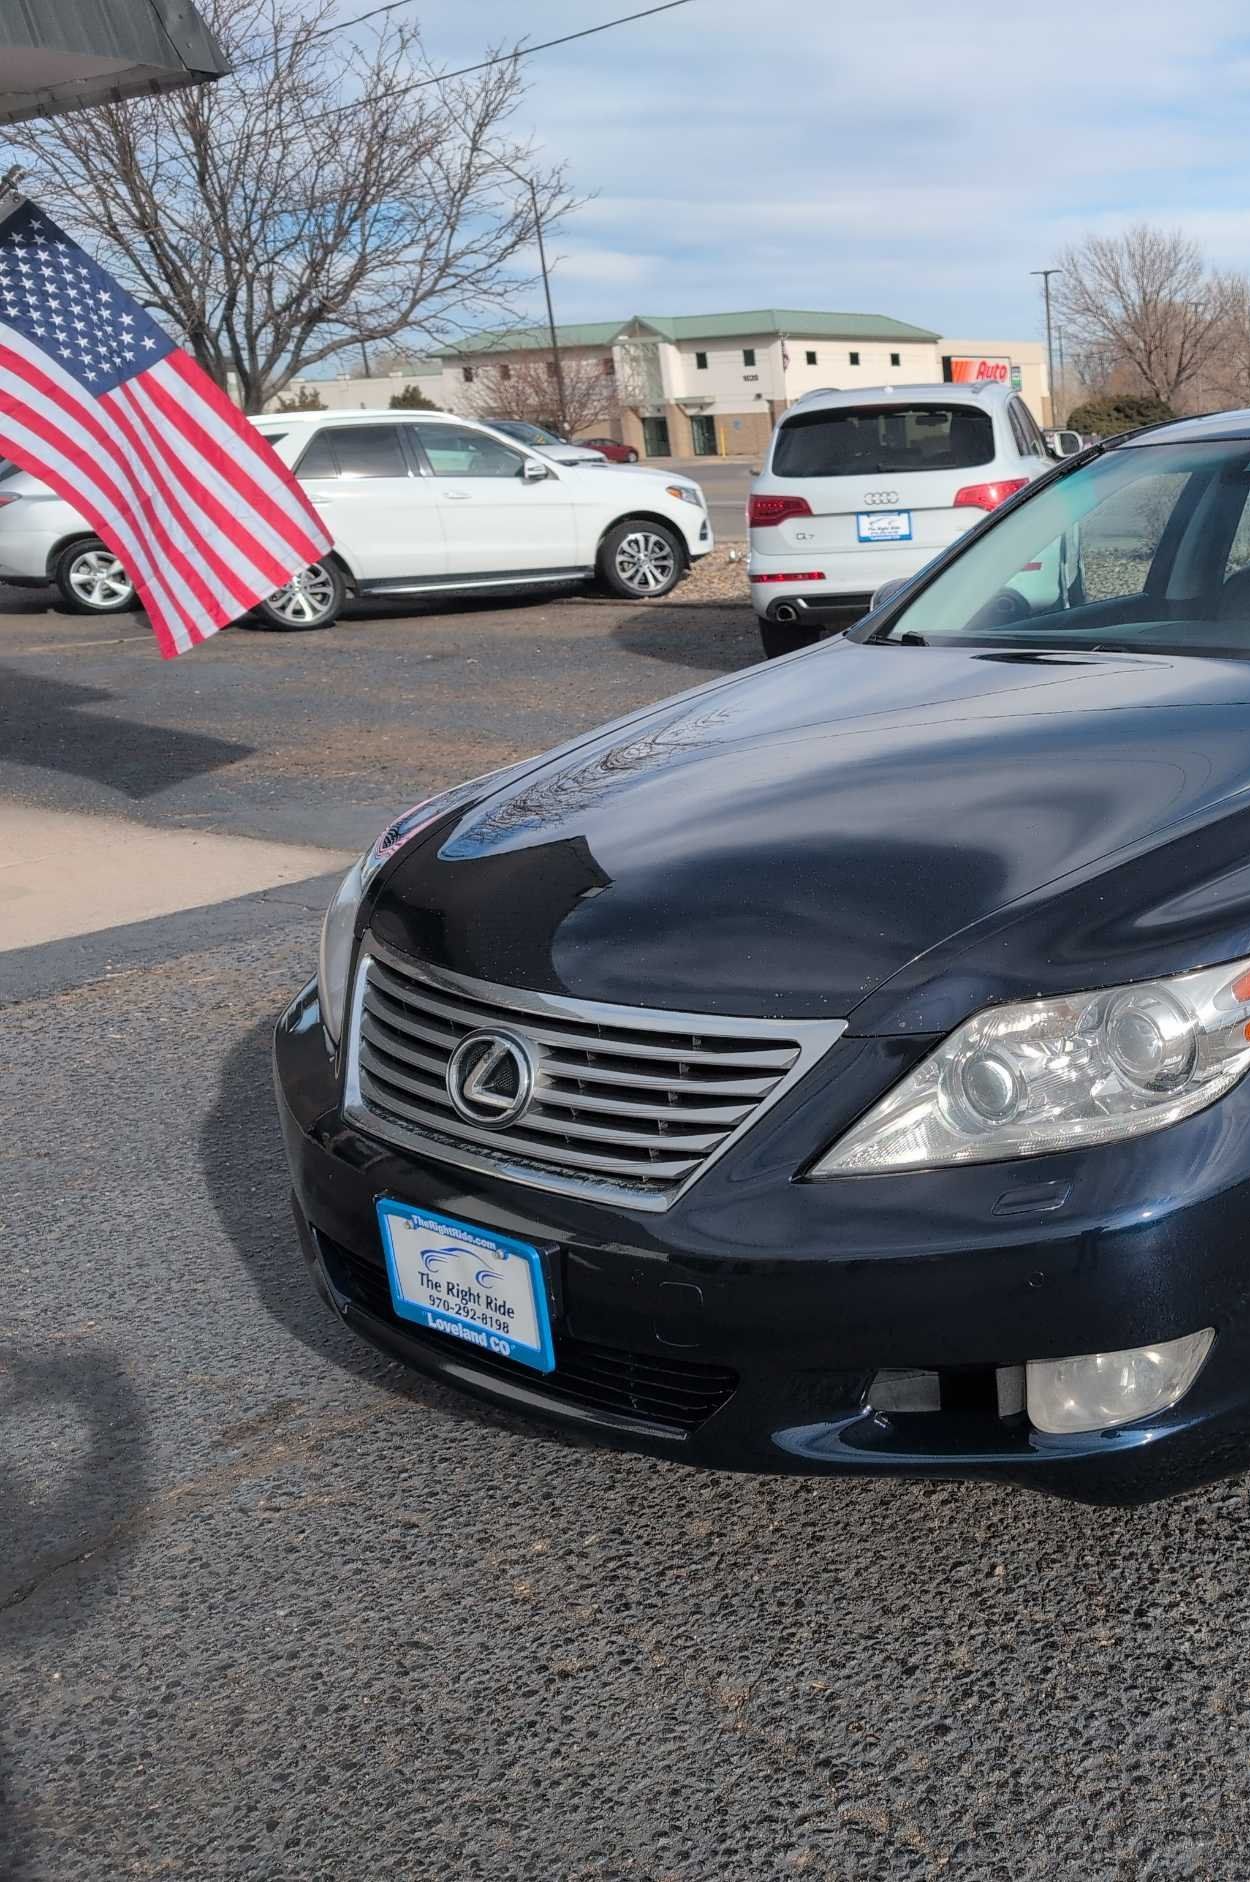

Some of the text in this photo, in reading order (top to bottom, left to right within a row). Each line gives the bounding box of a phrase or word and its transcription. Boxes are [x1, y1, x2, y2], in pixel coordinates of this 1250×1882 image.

[976, 360, 1007, 381] Auto
[411, 1214, 497, 1250] TheRightRide.com
[418, 1271, 515, 1319] The Right Ride
[428, 1294, 510, 1335] 970-292-8198
[427, 1313, 511, 1356] Loveland CO
